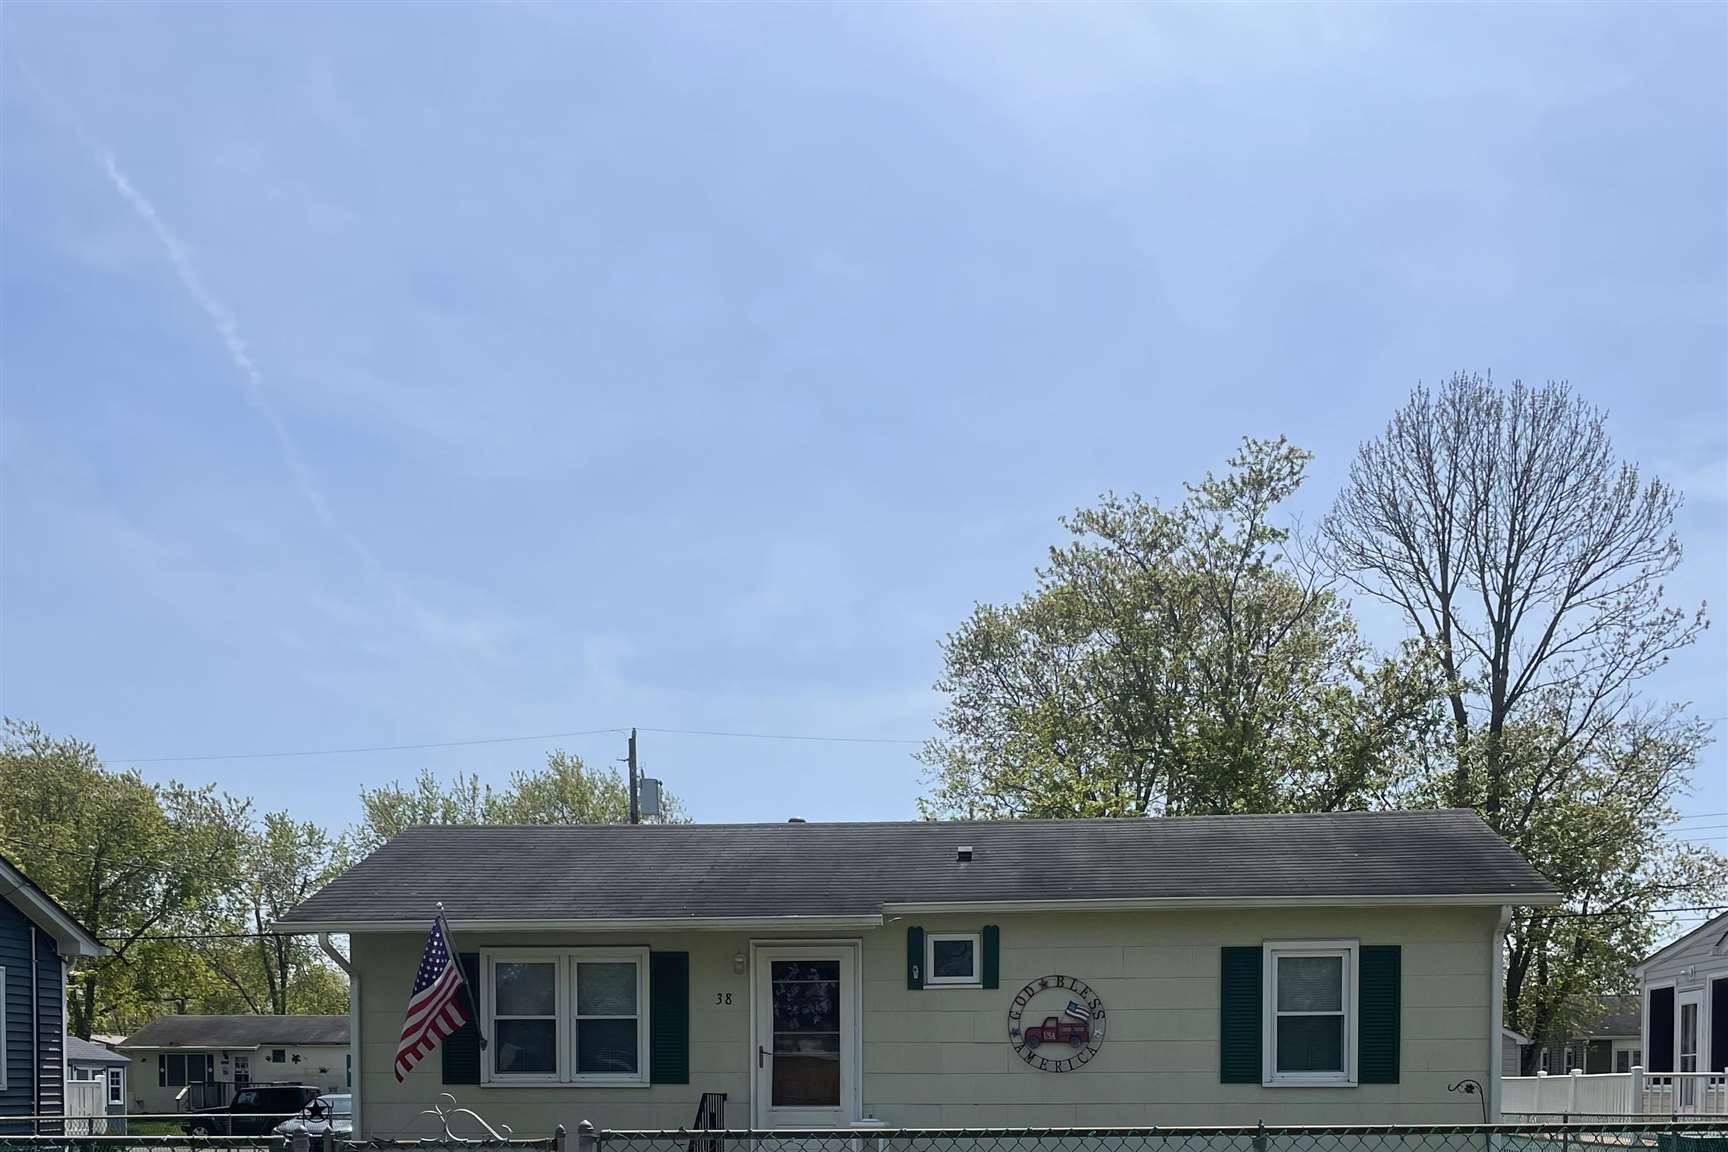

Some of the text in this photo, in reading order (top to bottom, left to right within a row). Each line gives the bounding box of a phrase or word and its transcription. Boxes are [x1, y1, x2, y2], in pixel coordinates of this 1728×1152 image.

[715, 992, 733, 1006] 38
[1009, 975, 1106, 1020] GOD BLESS
[1014, 1043, 1098, 1073] AMERICA
